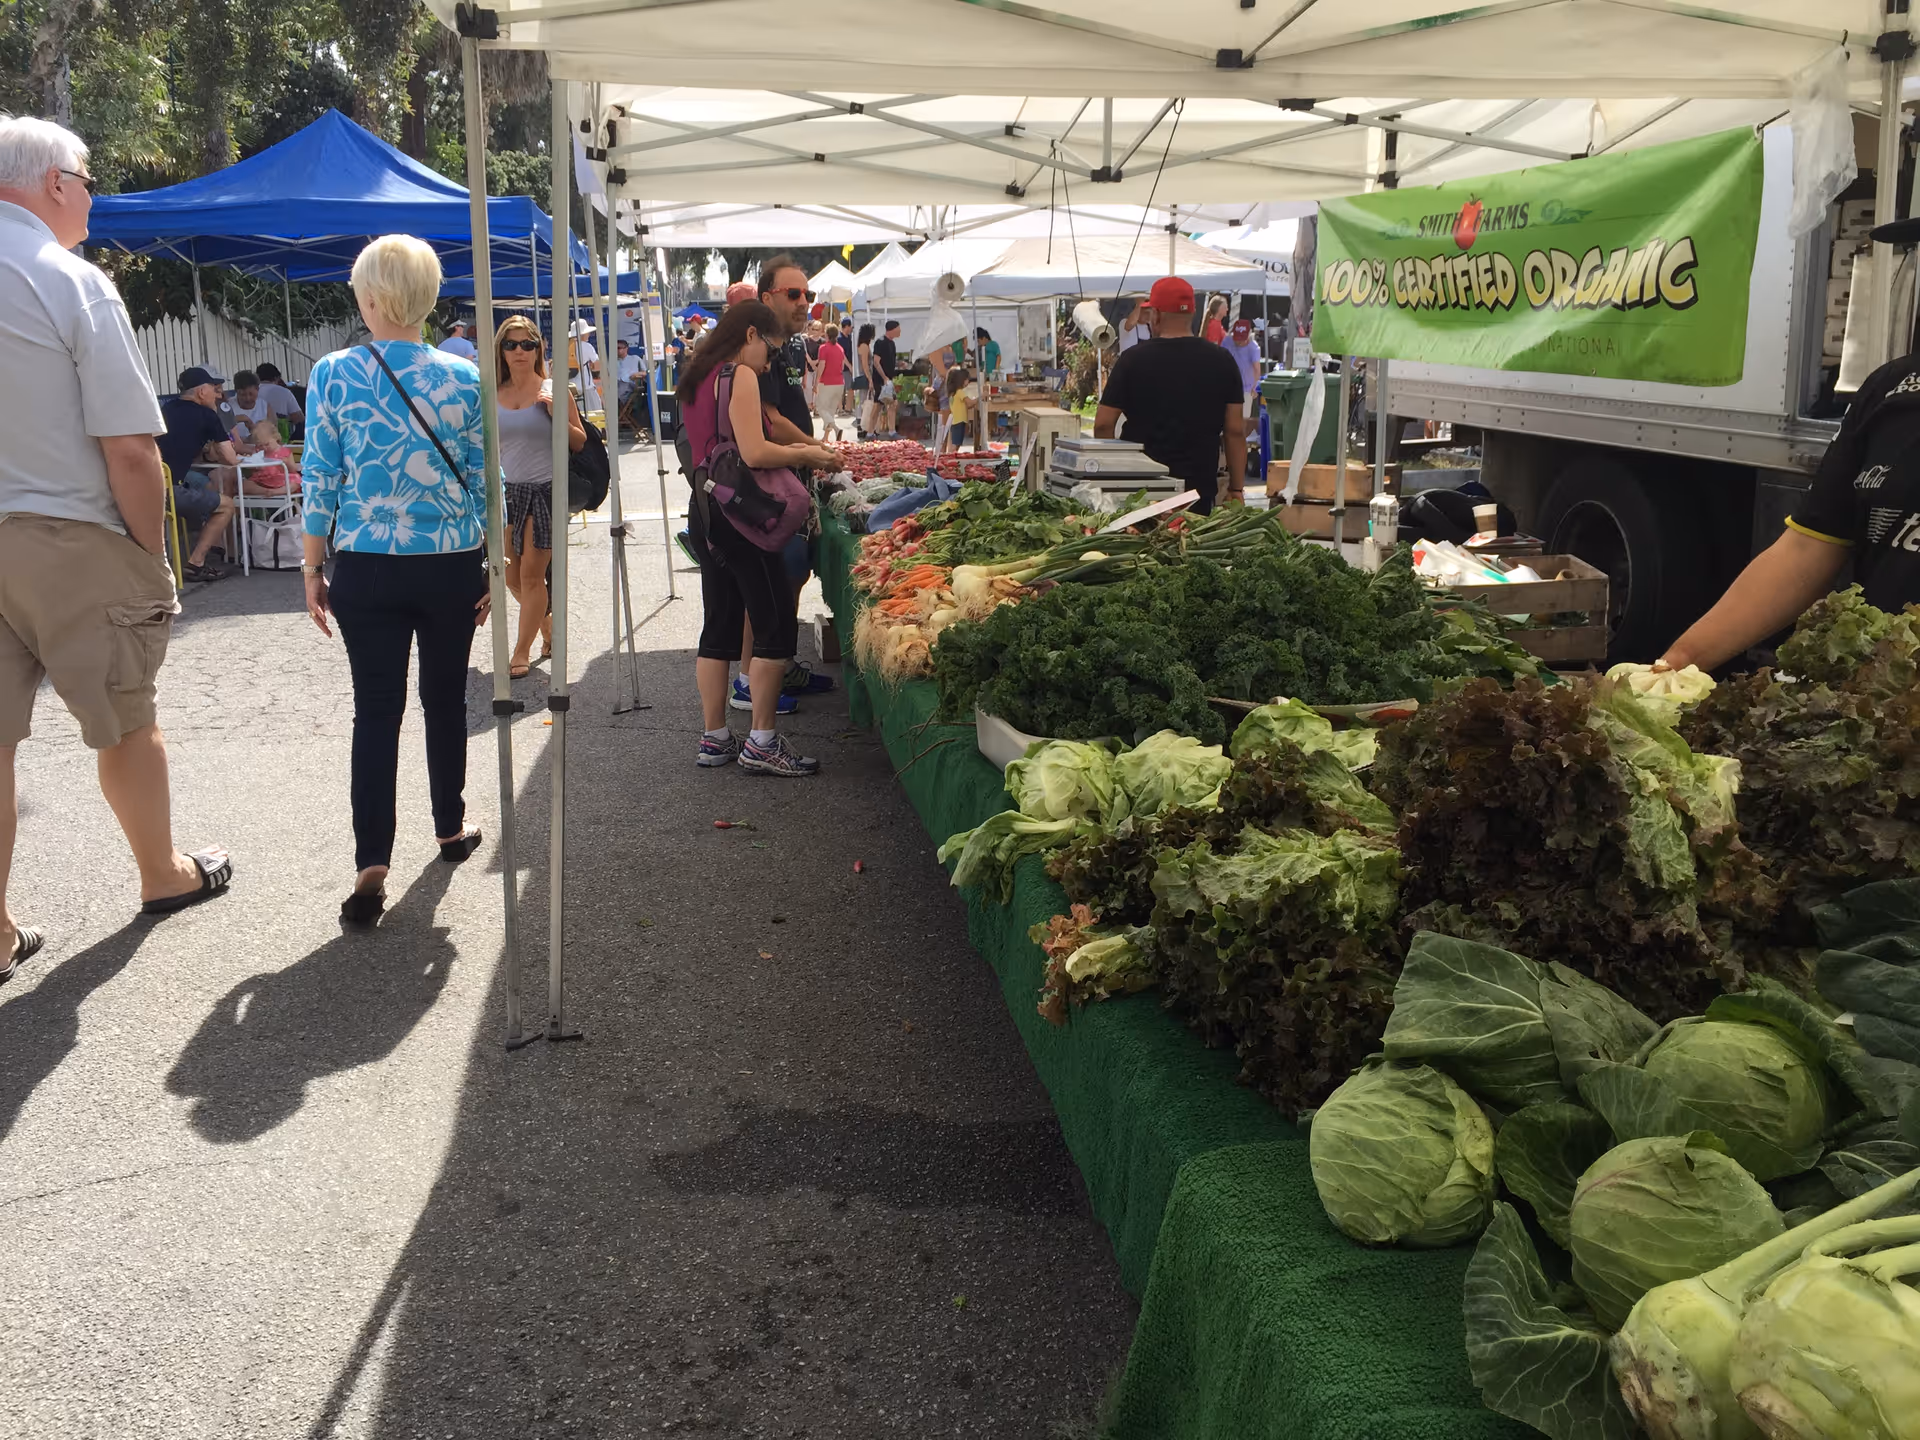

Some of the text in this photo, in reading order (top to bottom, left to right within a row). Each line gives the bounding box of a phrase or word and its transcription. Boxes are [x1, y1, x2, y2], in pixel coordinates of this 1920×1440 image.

[1416, 202, 1529, 238] SMITH FARMS
[1320, 236, 1698, 312] 100% CERTIFIED ORGANIC
